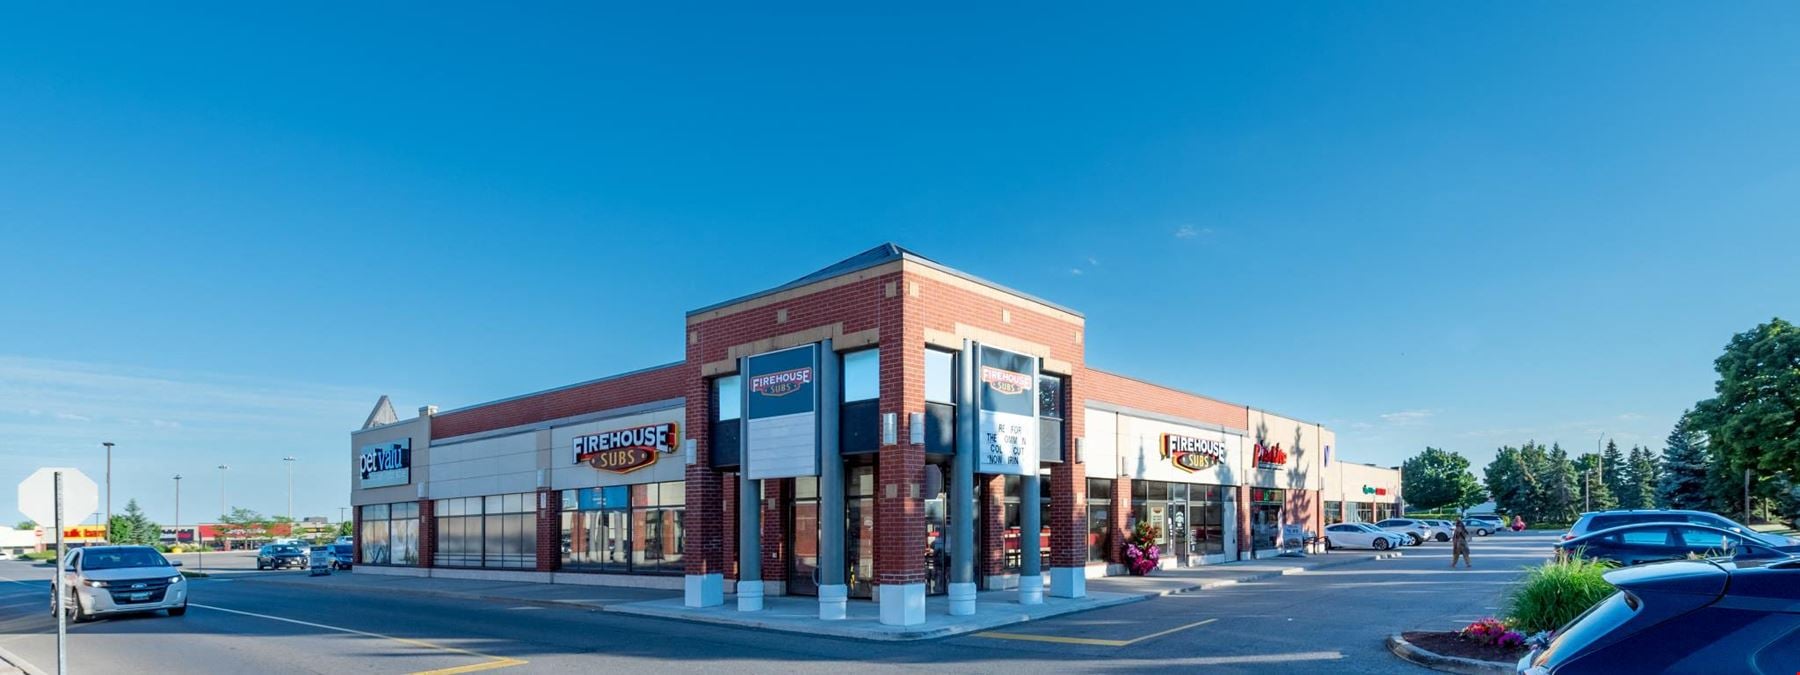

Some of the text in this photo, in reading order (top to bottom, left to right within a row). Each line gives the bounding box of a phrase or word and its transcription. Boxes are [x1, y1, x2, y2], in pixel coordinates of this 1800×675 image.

[752, 370, 810, 392] FIREHOUSE
[770, 382, 791, 394] SUBS
[982, 368, 1032, 390] FIREHOUSE
[998, 381, 1015, 392] SUBS
[572, 423, 669, 465] FIREHOUSE
[986, 432, 997, 443] THE
[600, 449, 635, 468] SUBS
[1169, 434, 1225, 464] FIREHOUSE
[360, 448, 402, 480] pet valu
[1189, 454, 1209, 468] SUBS
